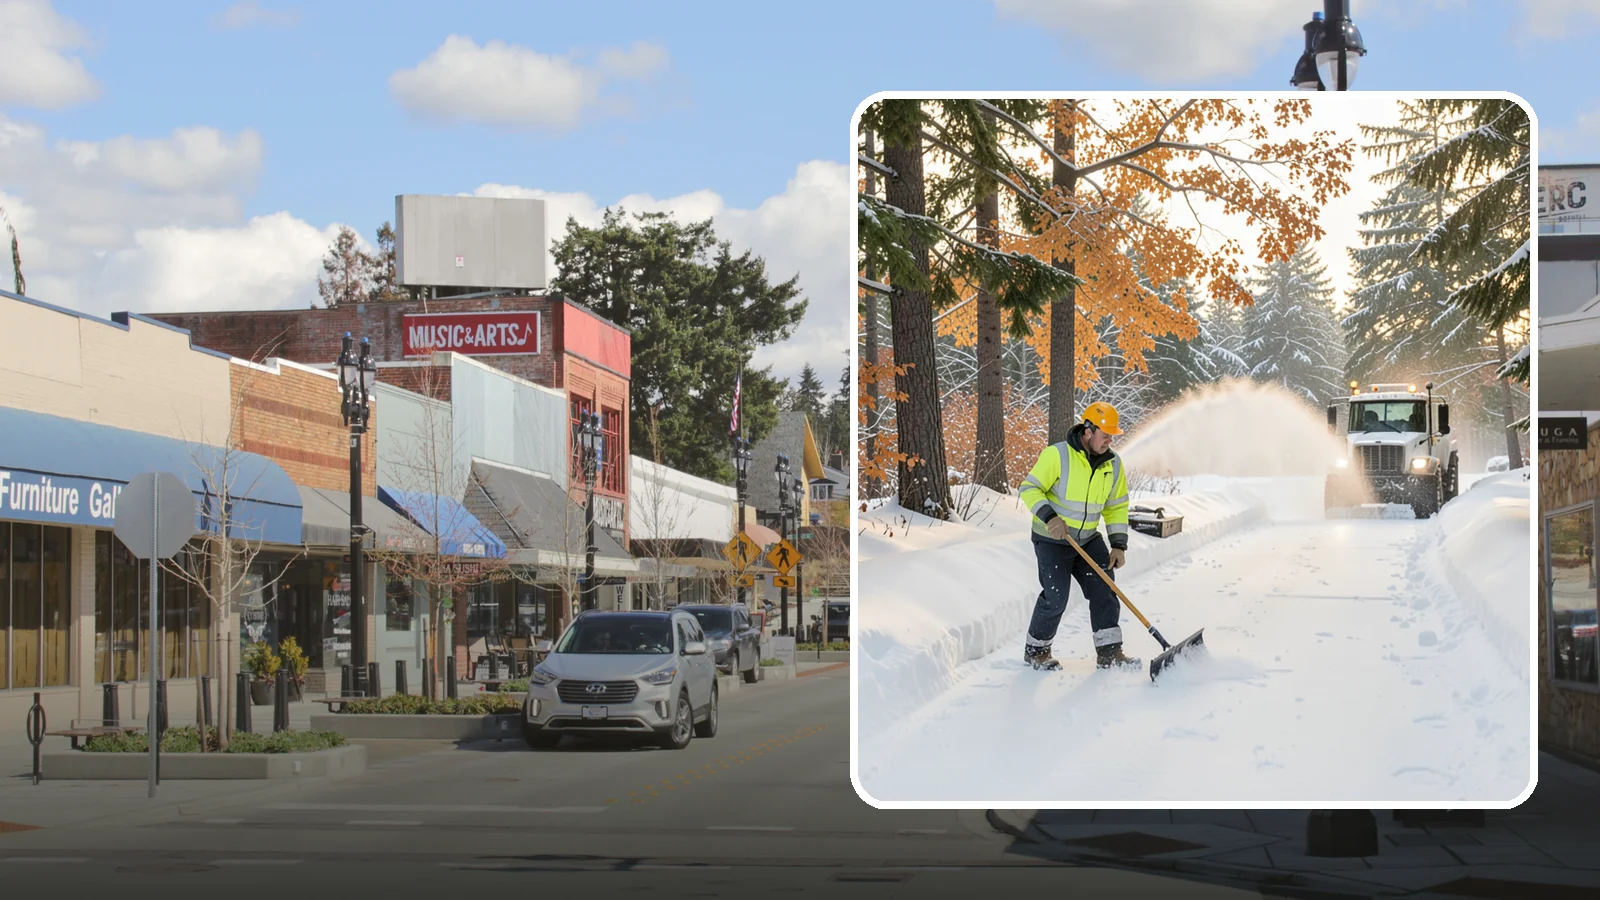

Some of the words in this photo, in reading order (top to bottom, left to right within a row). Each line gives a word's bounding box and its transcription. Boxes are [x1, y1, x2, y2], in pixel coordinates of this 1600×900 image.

[409, 323, 519, 349] MUSIC&ARTS
[1540, 428, 1577, 436] UGA
[0, 471, 79, 515] Furniture
[453, 563, 479, 574] SUSHI
